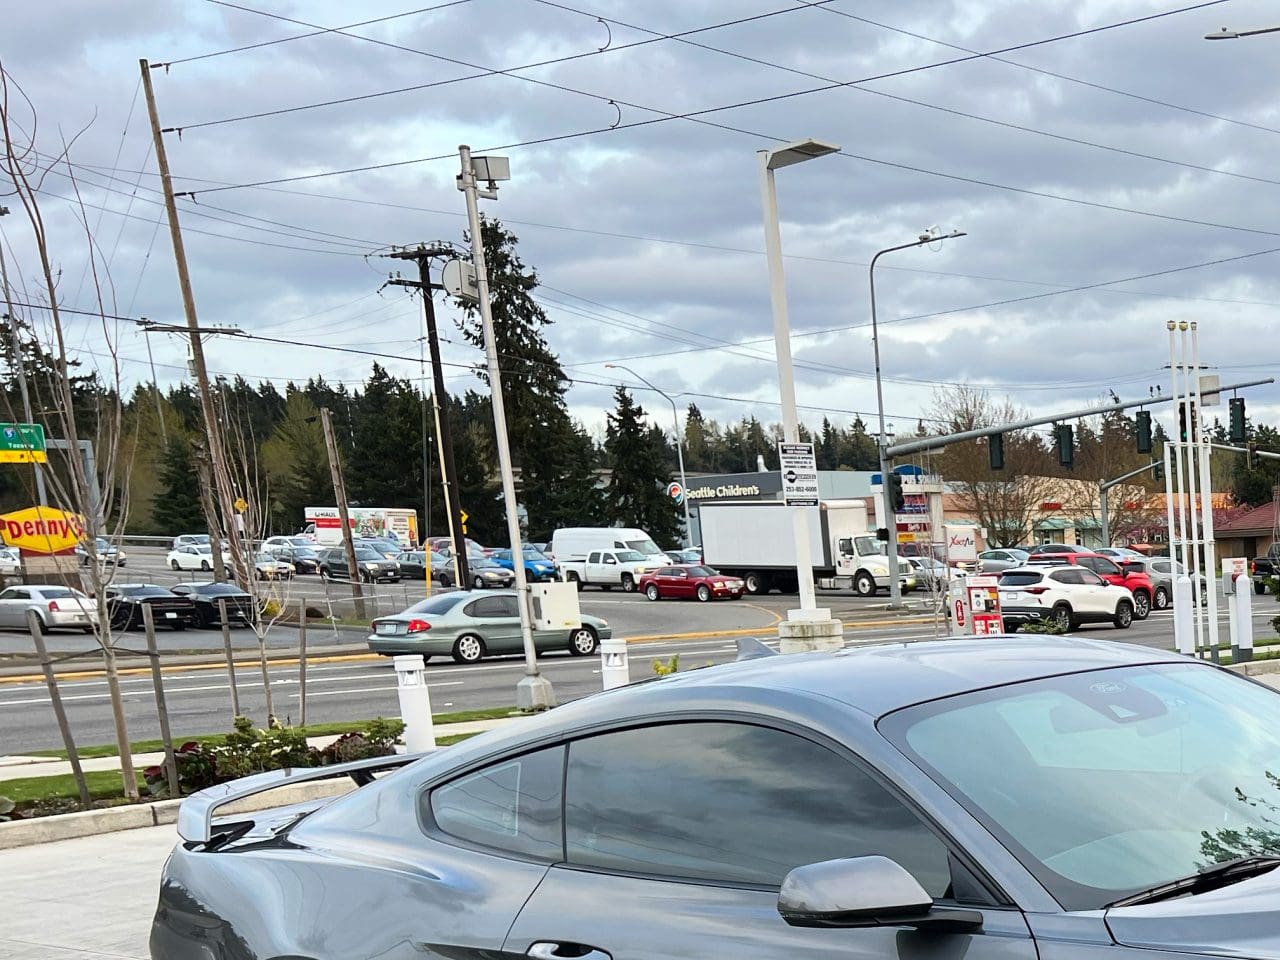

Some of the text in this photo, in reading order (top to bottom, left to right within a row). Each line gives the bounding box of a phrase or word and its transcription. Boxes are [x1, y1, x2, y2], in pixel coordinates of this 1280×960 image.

[685, 484, 760, 499] Seattle Children's
[6, 517, 83, 540] Denny's
